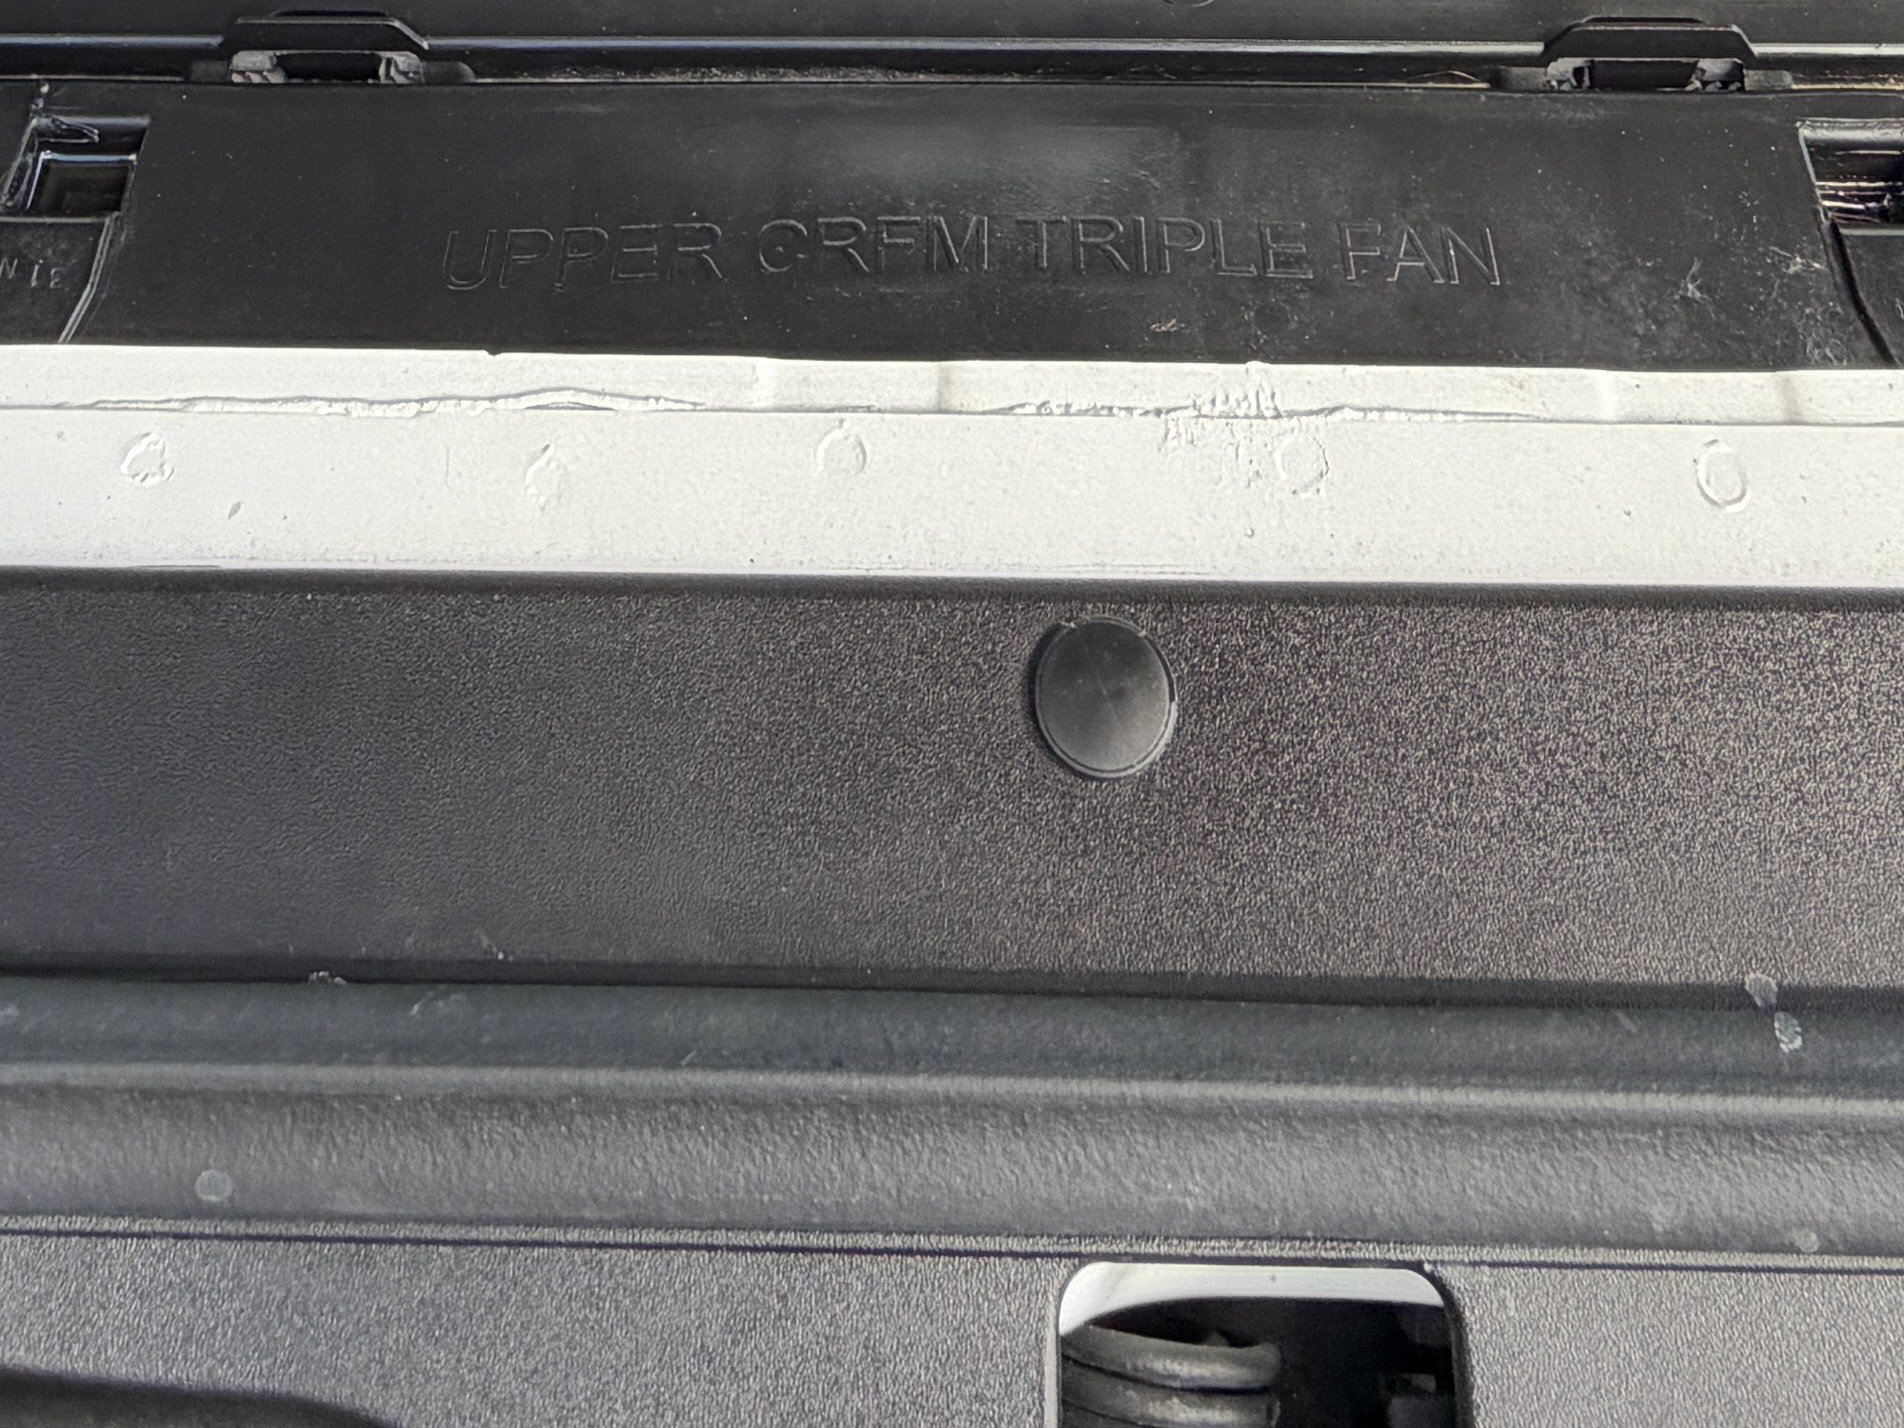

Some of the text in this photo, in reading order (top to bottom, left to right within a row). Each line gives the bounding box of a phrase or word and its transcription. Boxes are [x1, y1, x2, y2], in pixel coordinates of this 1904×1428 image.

[441, 222, 724, 292] UPPER
[1020, 215, 1314, 281] TRIPLE
[1340, 222, 1504, 288] FAN
